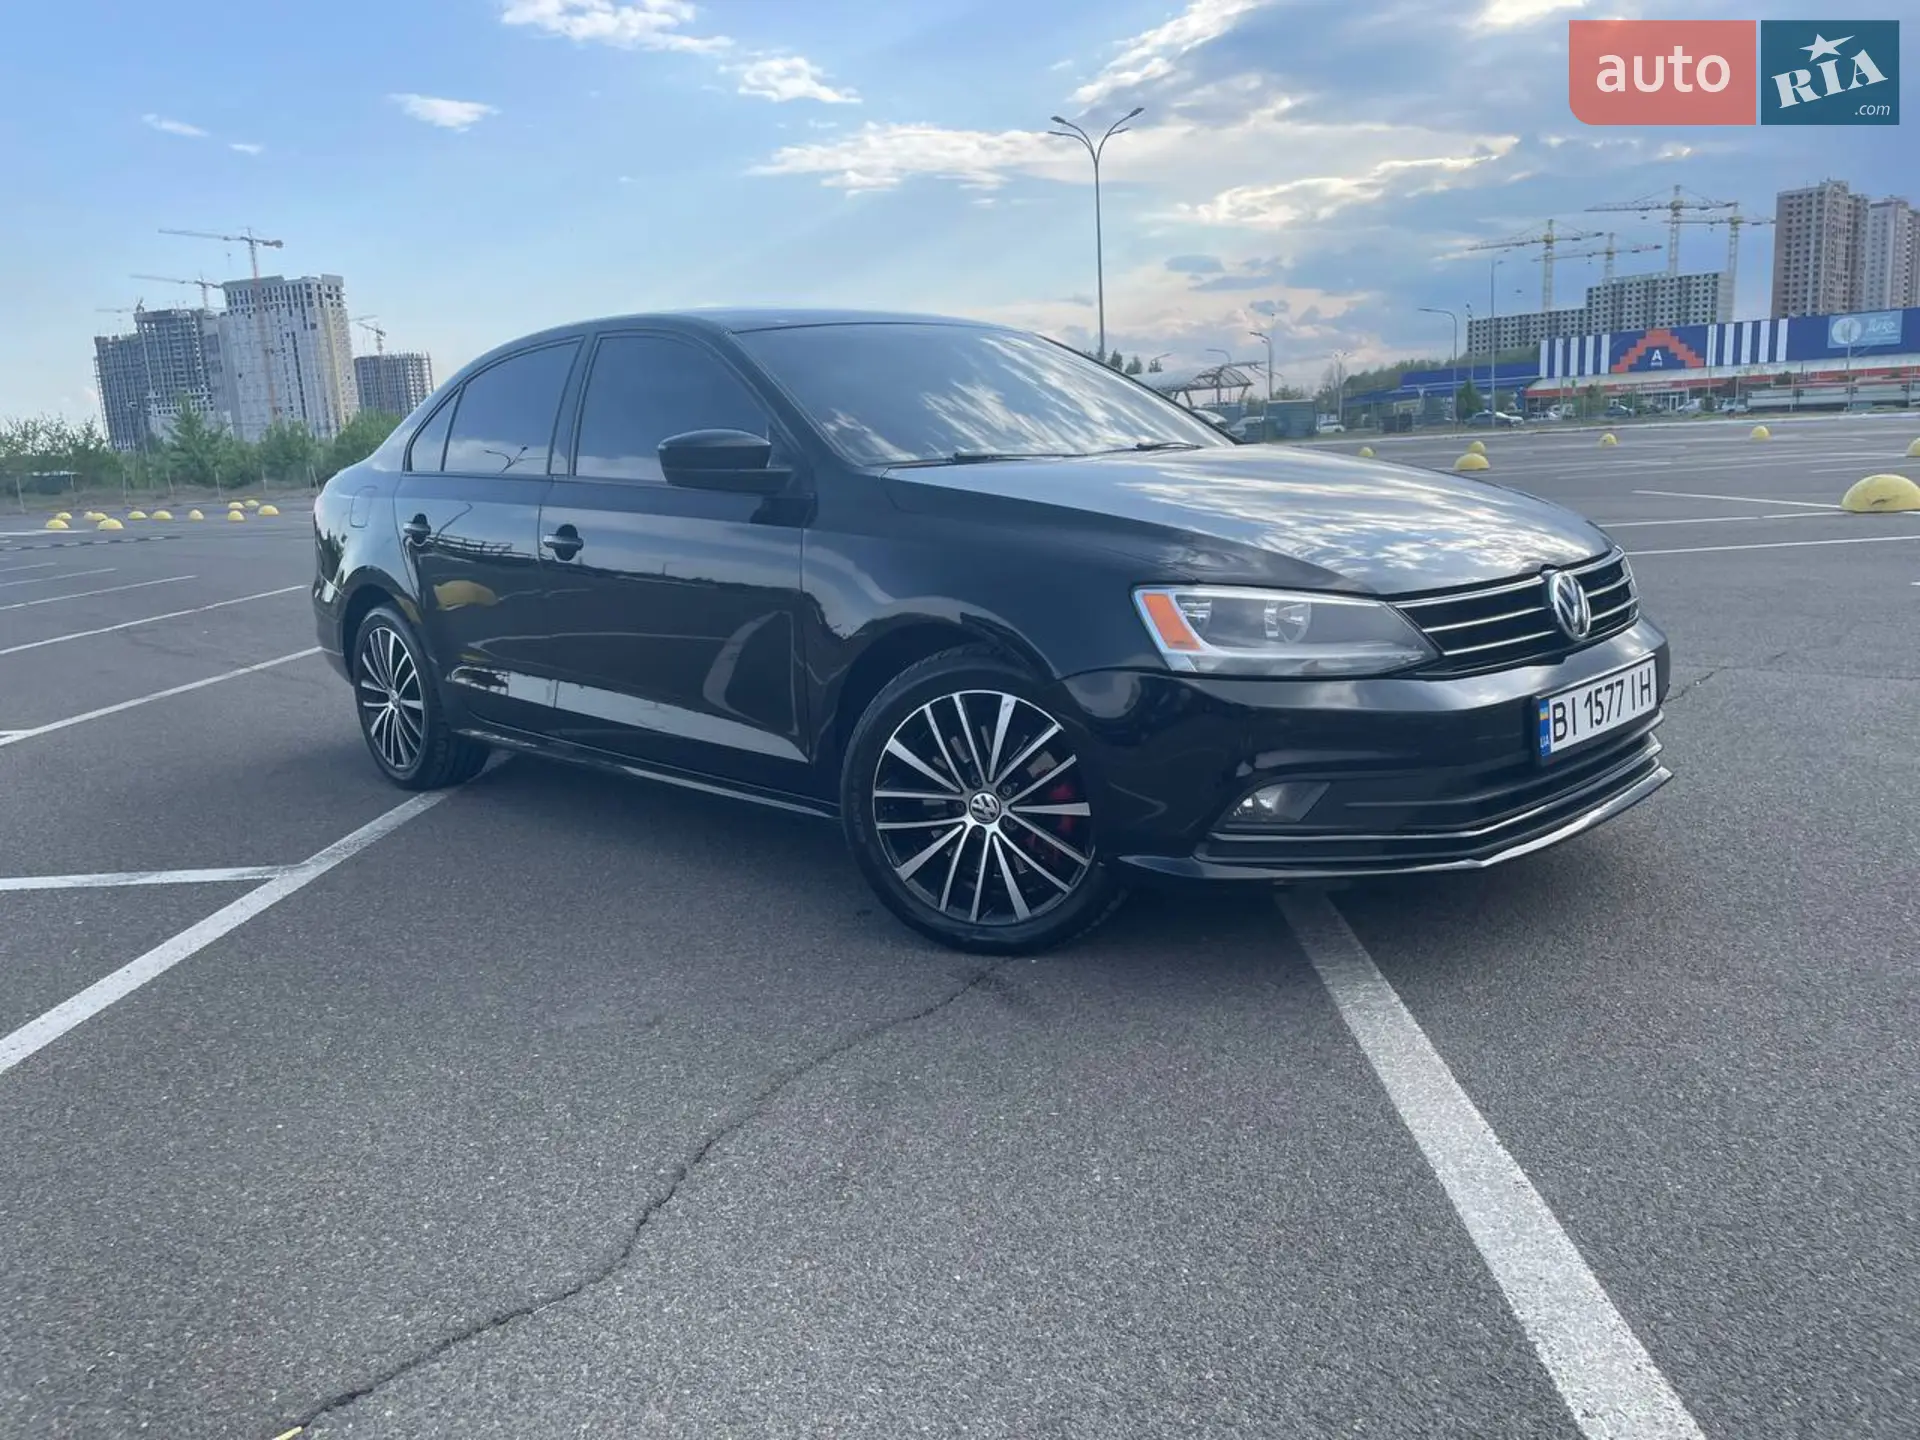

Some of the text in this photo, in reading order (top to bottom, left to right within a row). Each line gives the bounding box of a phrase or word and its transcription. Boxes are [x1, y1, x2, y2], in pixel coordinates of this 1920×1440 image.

[1552, 667, 1652, 743] BI 1577 IH
